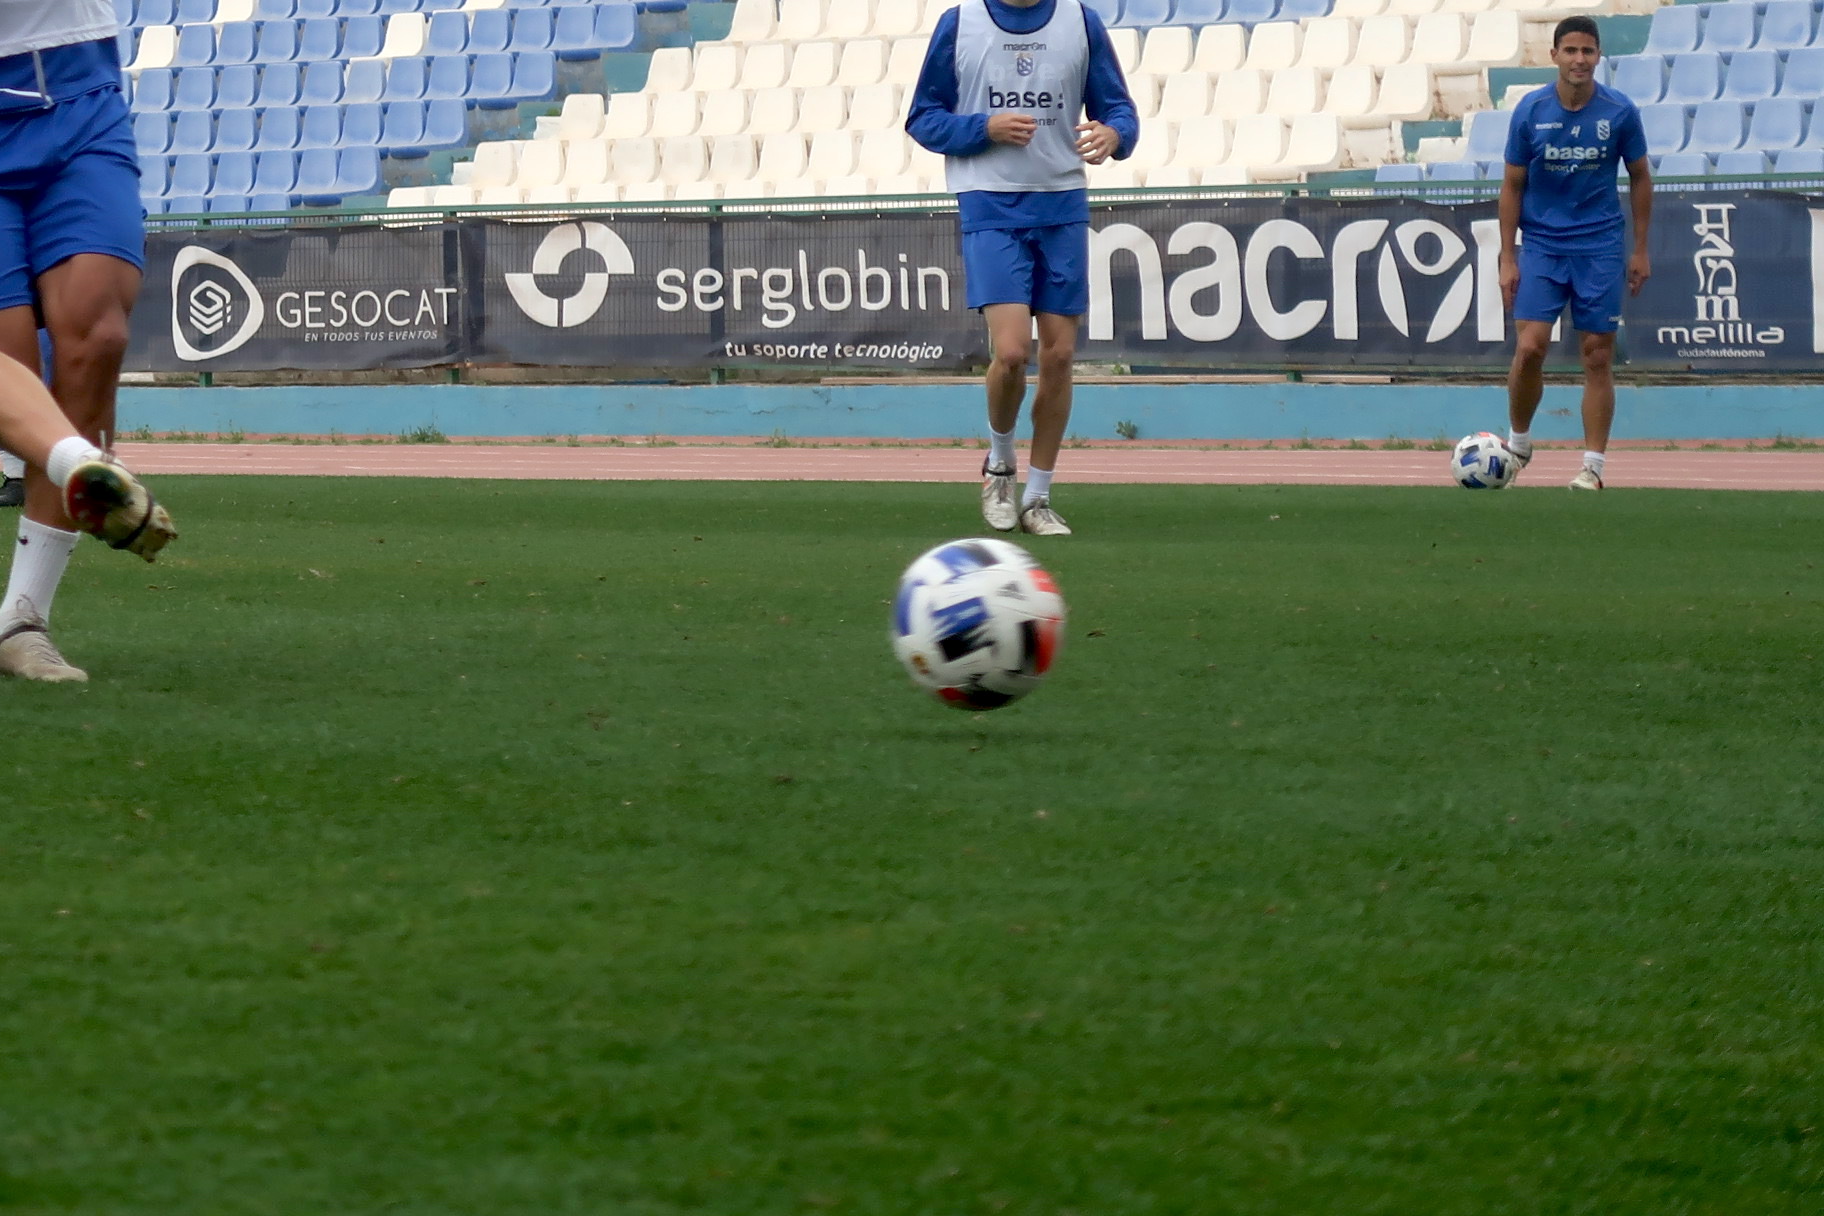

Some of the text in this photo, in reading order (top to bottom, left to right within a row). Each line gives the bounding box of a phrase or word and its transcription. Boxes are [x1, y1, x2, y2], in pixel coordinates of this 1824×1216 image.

[1003, 42, 1047, 51] macron
[656, 249, 950, 329] serglobin
[276, 287, 458, 328] GESOCAT
[304, 330, 438, 342] EN TODOS TUS EVENTOS
[1657, 322, 1785, 345] melilla
[725, 341, 944, 363] tu soporte tecnológico
